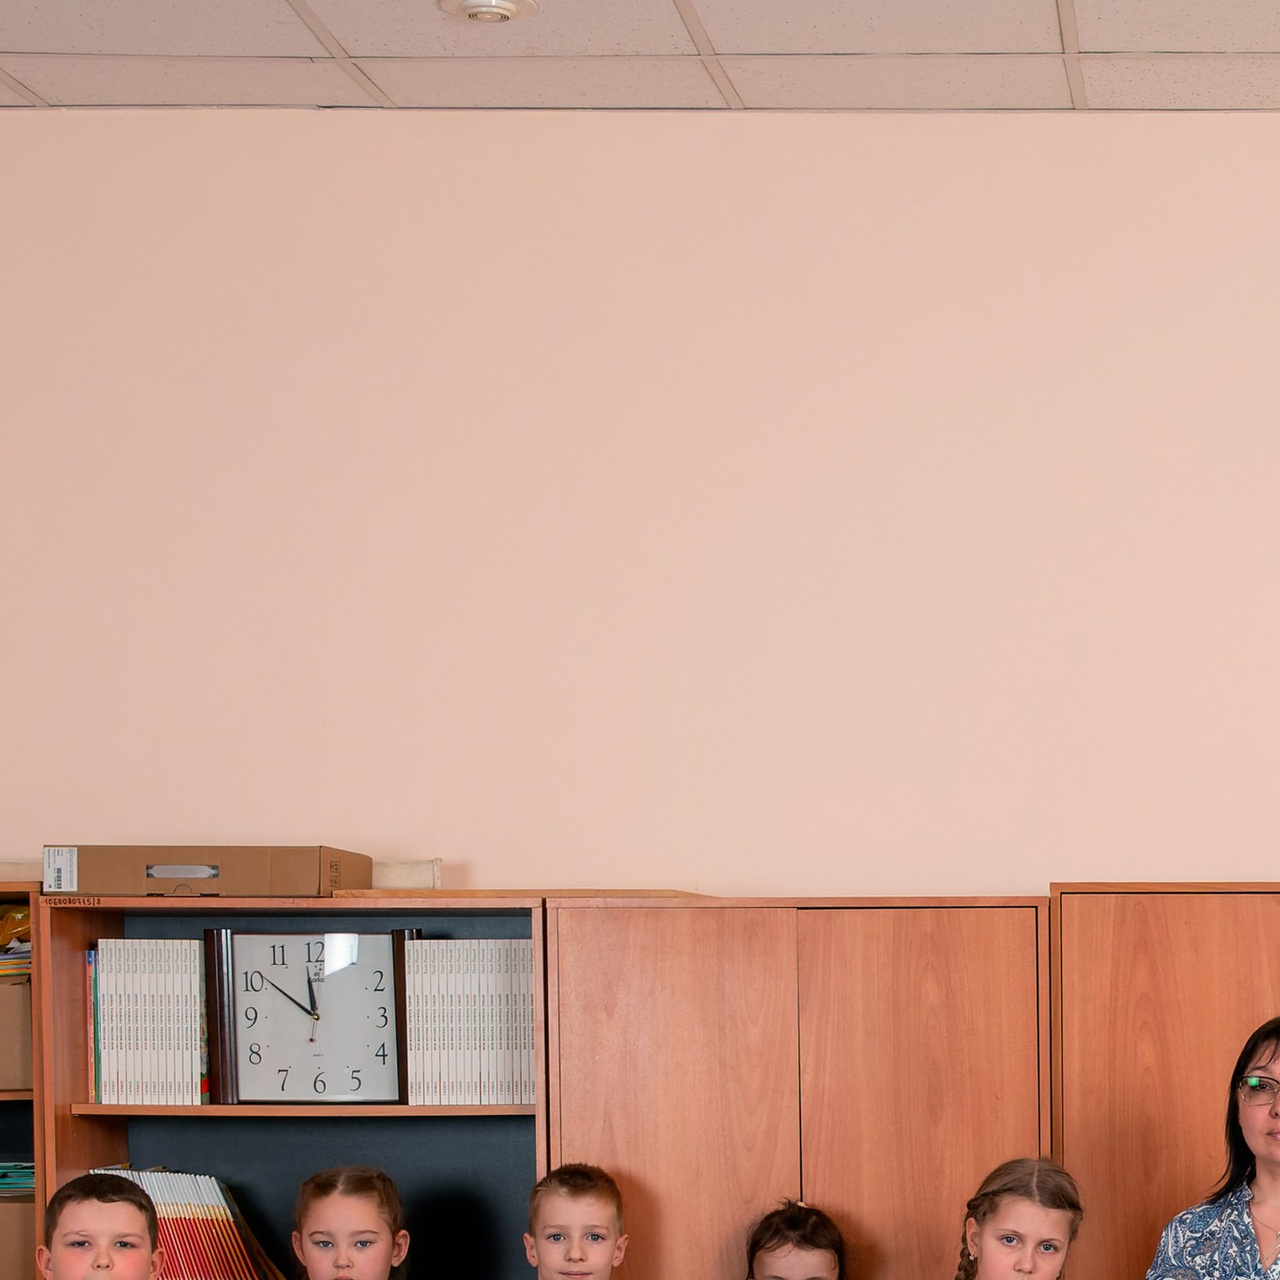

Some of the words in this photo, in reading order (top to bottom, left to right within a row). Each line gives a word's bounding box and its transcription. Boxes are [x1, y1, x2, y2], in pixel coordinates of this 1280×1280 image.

[270, 944, 288, 966] 11
[304, 941, 325, 963] 12
[243, 970, 264, 992] 10
[373, 970, 386, 992] 2
[244, 1006, 258, 1029] 9
[376, 1006, 389, 1029] 3
[248, 1042, 262, 1065] 8
[374, 1042, 388, 1066] 4
[277, 1069, 289, 1092] 7
[313, 1071, 327, 1094] 6
[350, 1069, 362, 1092] 5
